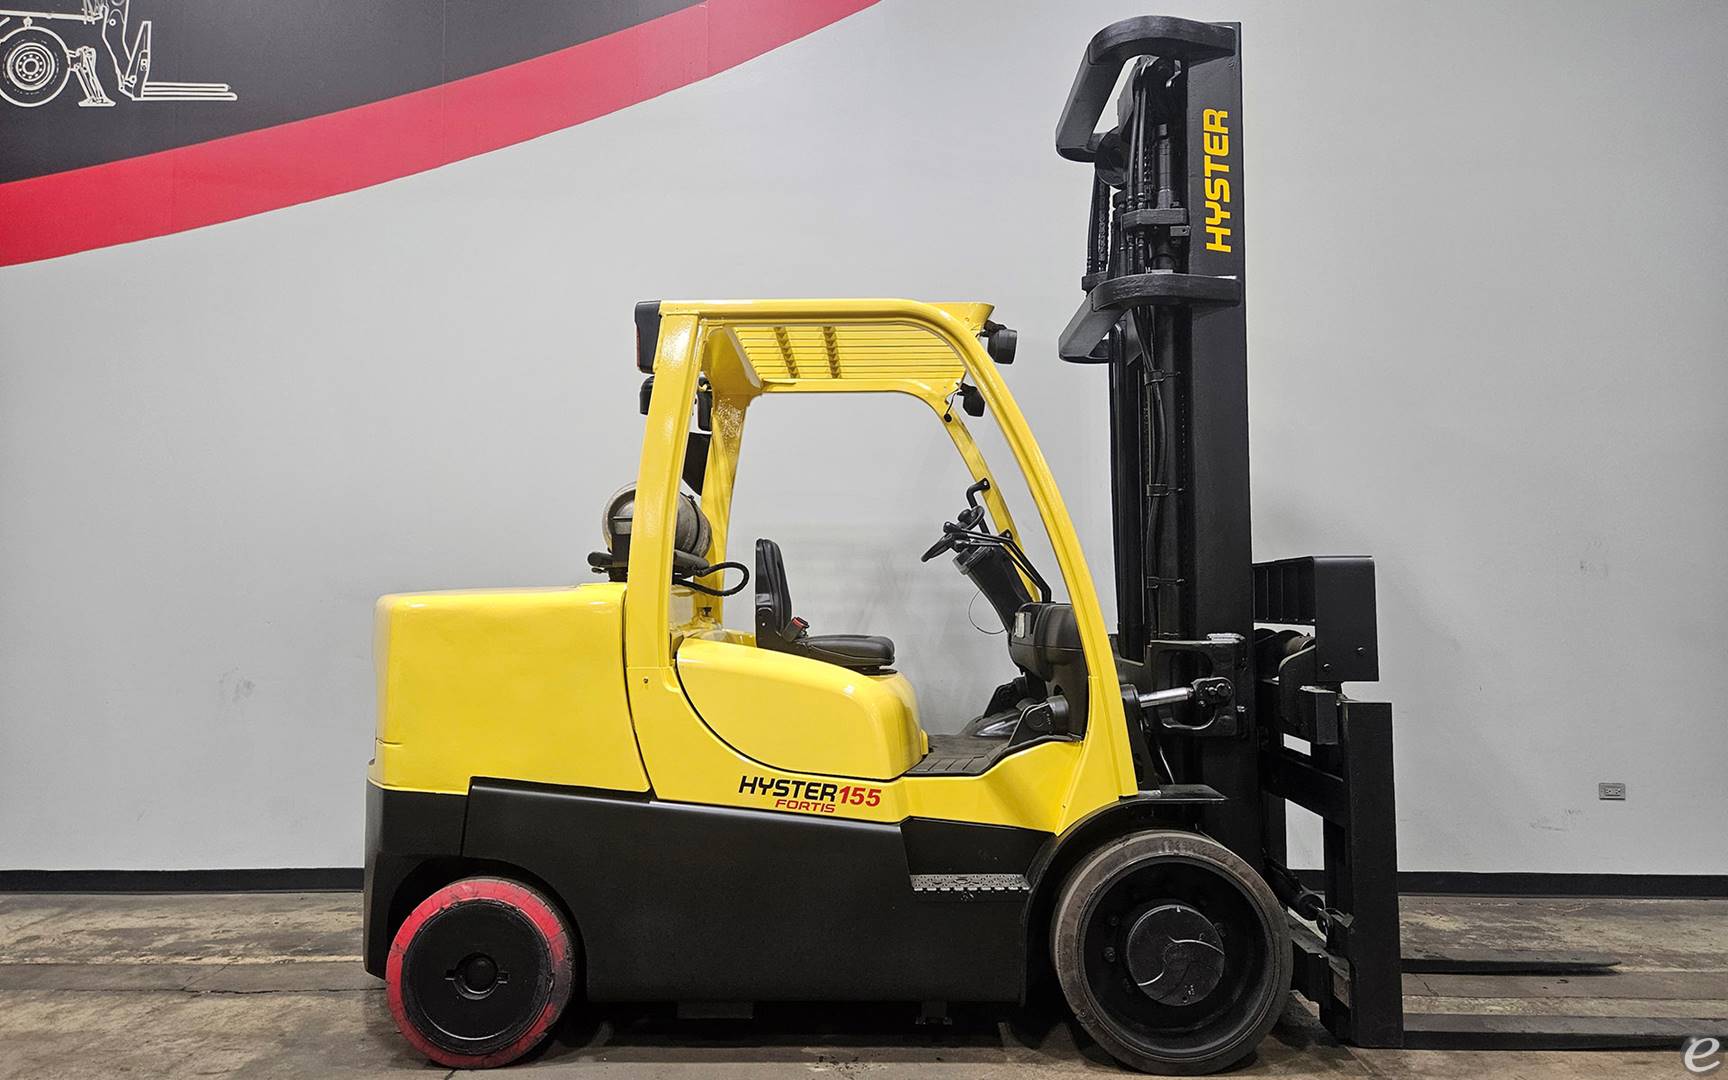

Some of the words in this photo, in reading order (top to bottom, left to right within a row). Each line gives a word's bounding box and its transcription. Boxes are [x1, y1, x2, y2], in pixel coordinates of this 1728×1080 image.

[1203, 108, 1232, 253] HYSTER
[738, 775, 838, 803] HYSTER
[839, 785, 882, 807] 155
[775, 799, 836, 814] FORTIS
